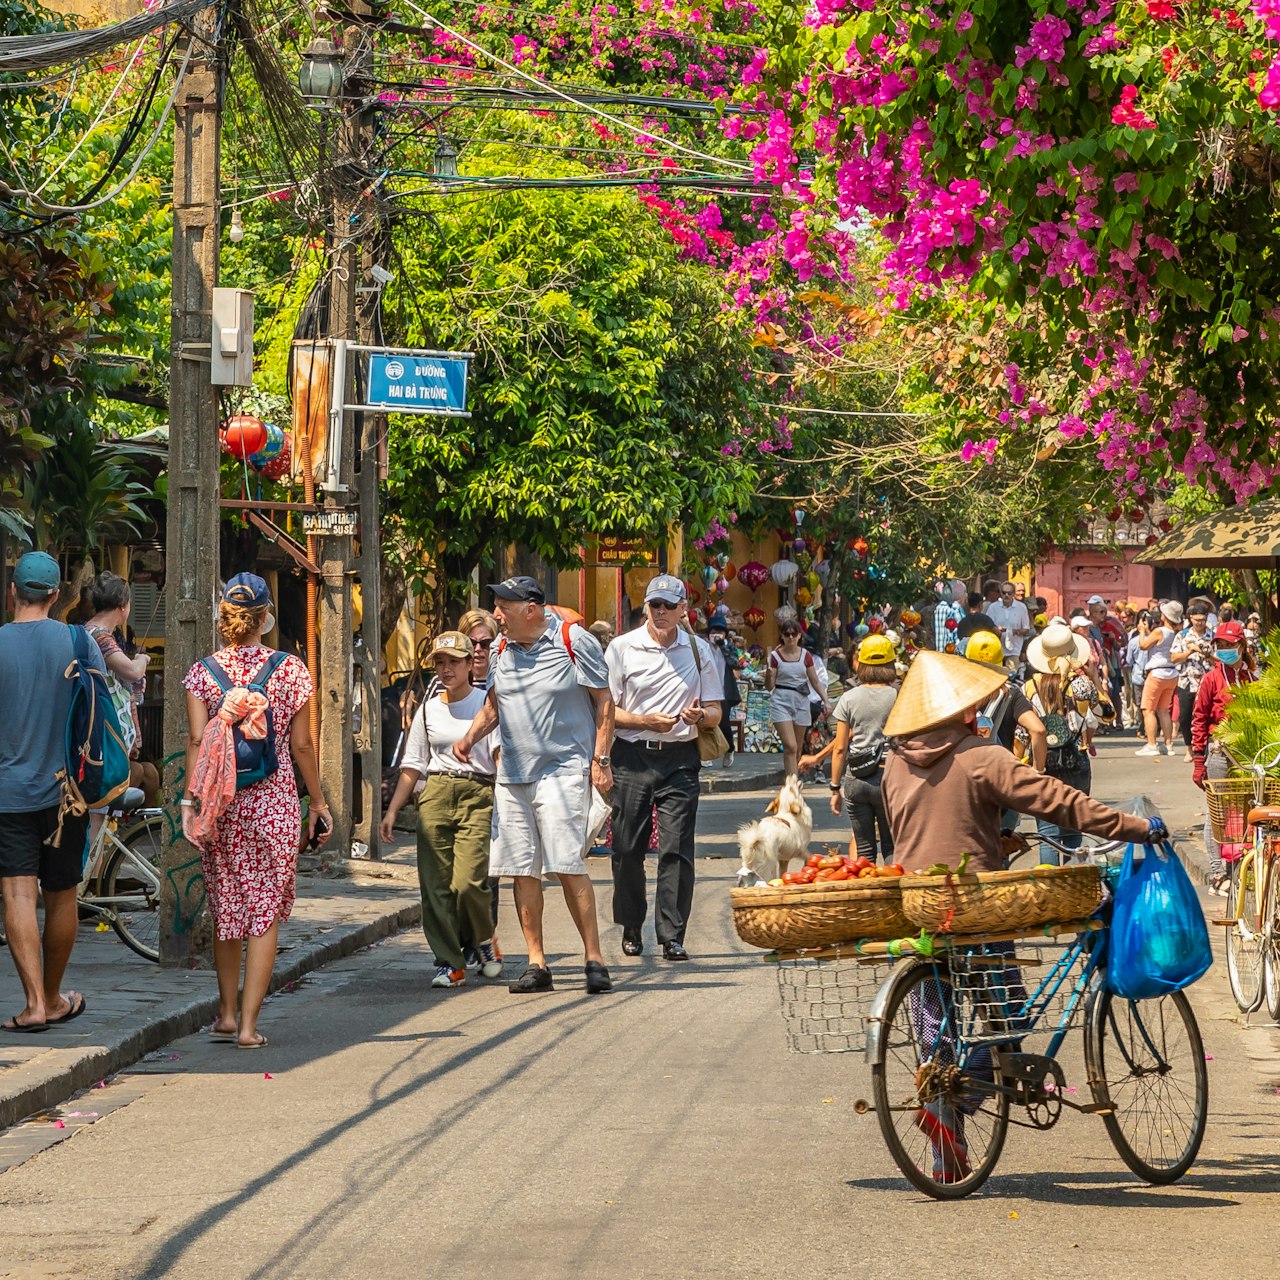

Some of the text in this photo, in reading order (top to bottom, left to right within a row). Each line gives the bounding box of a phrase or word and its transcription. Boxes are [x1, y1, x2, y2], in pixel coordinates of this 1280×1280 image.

[415, 364, 447, 378] ĐƯỜNG
[388, 382, 448, 401] HAI BÀ TRƯNG
